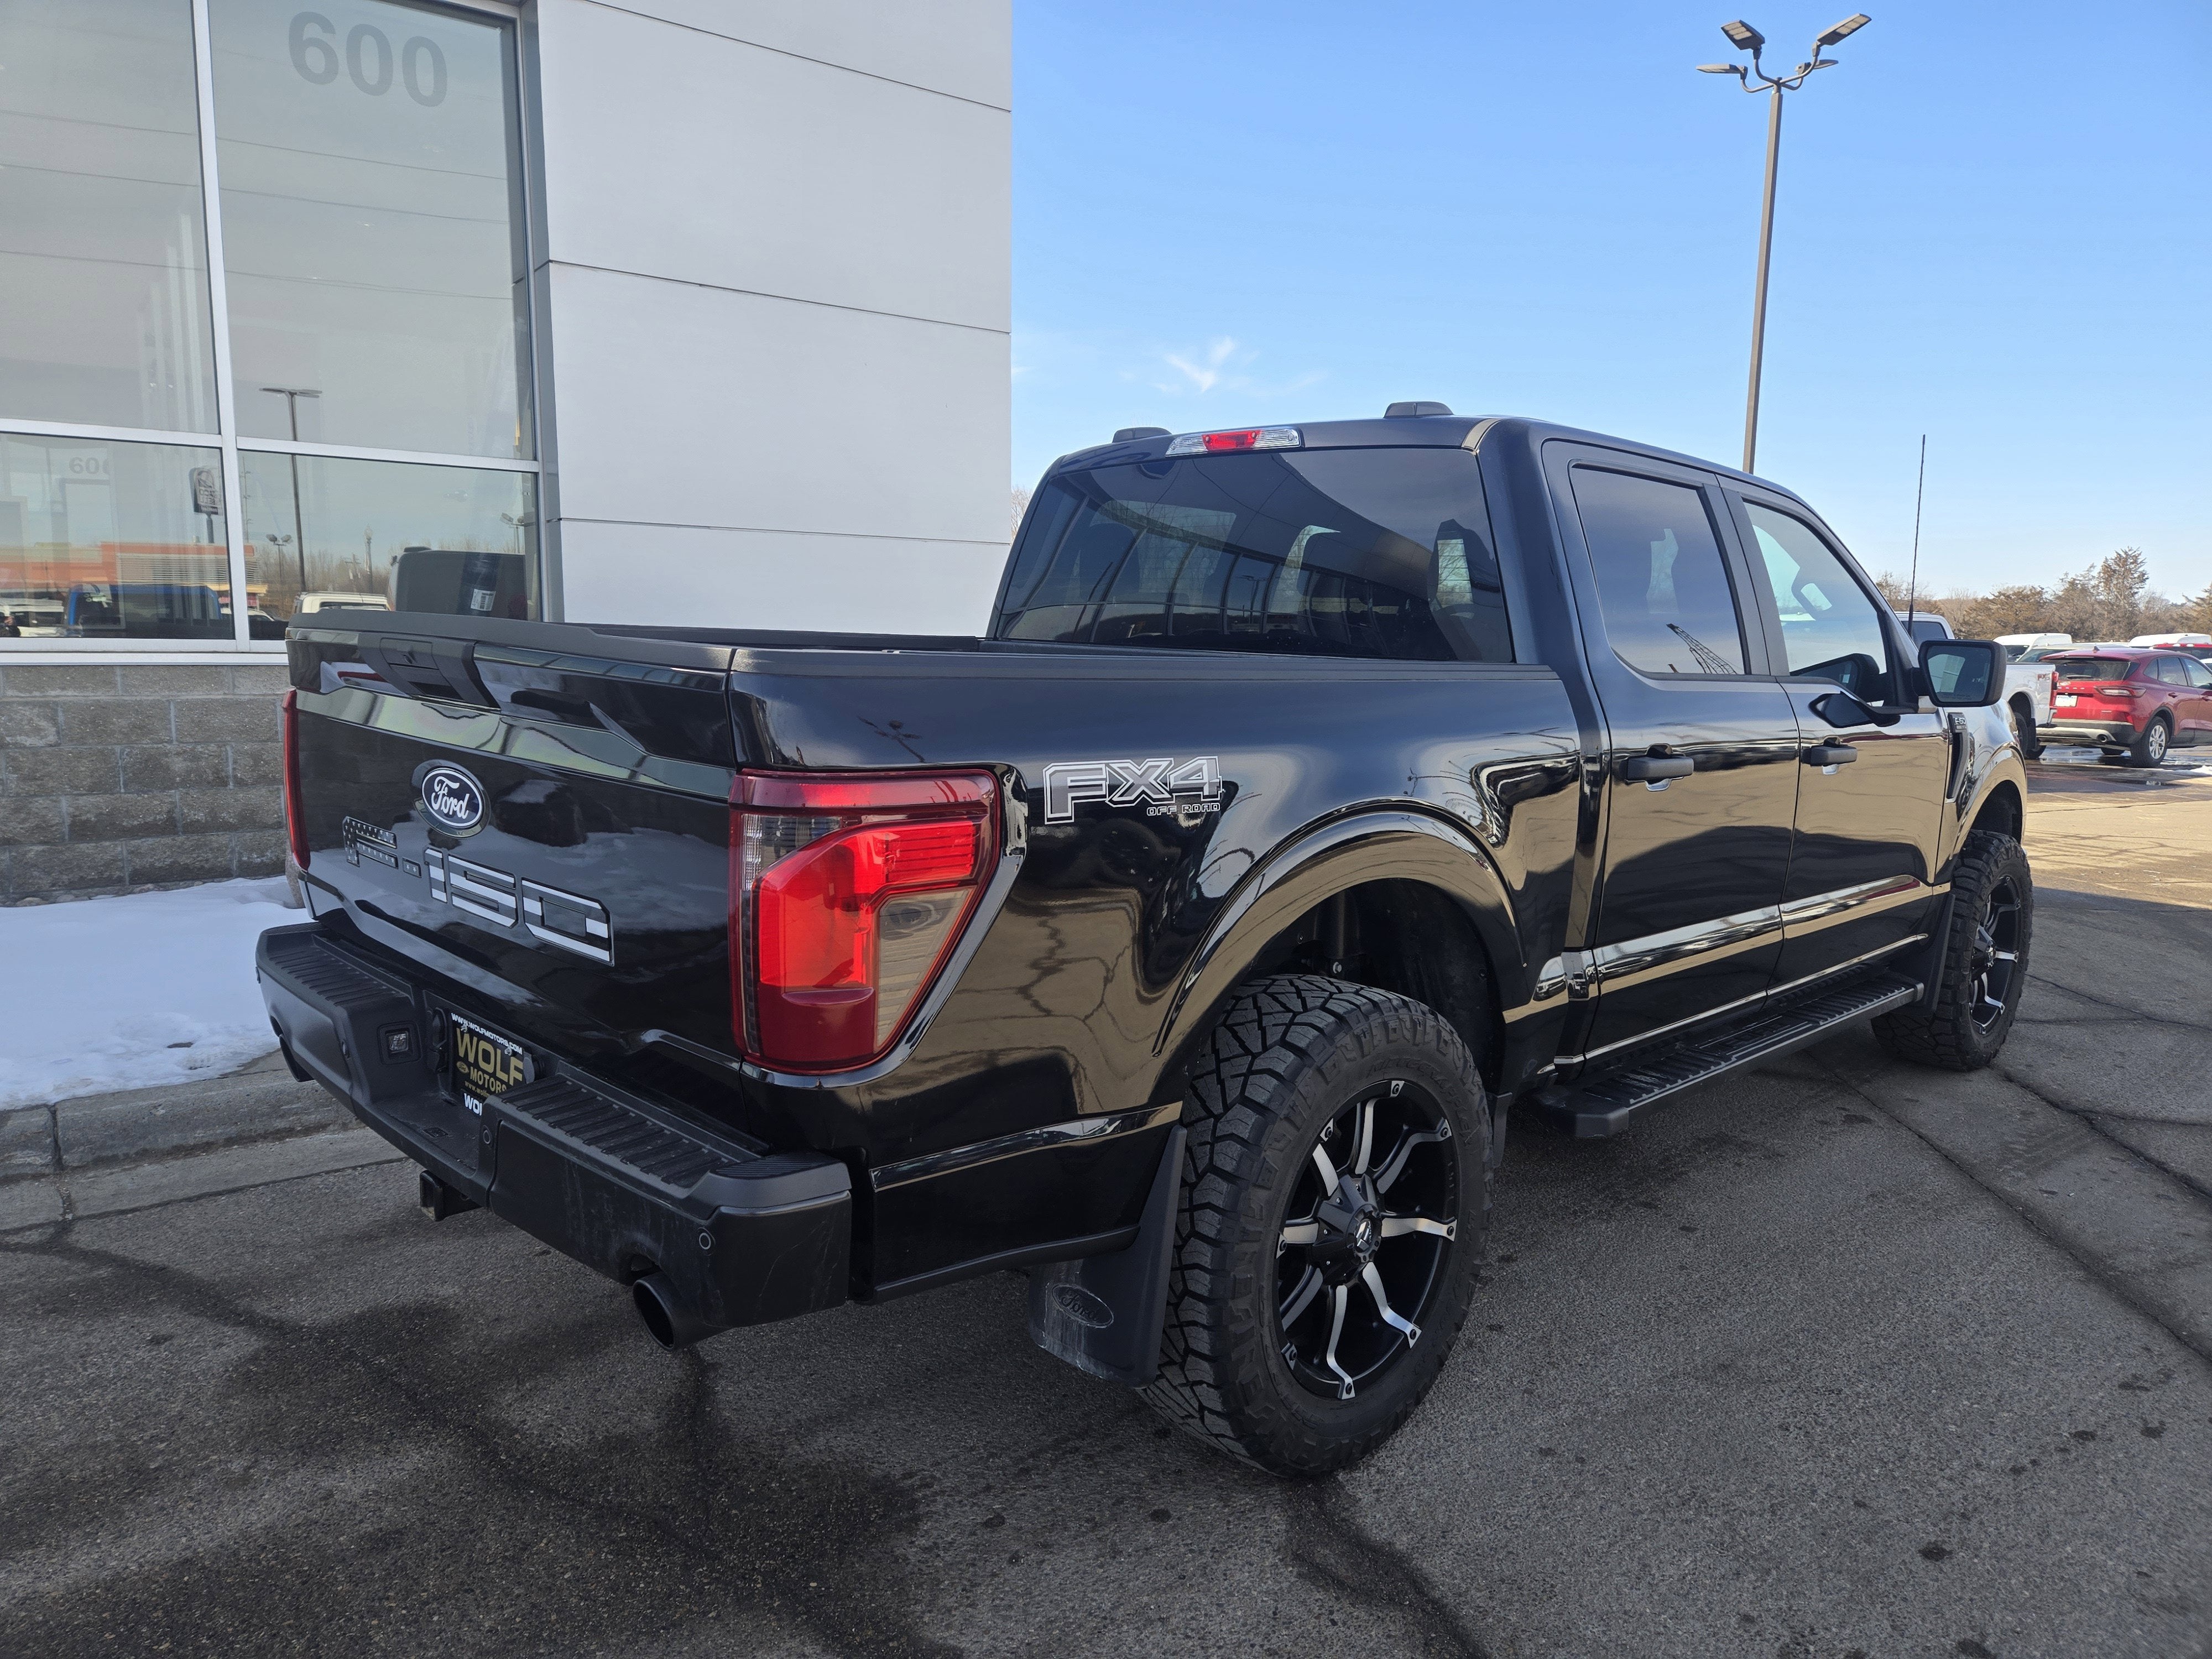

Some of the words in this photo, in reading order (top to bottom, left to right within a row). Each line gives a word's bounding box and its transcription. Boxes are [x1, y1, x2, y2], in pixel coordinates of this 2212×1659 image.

[288, 11, 448, 107] 600
[431, 776, 470, 820] Ford
[1042, 755, 1223, 825] FX4
[1146, 805, 1177, 816] OFF
[1181, 802, 1220, 814] ROAD
[342, 816, 614, 967] F-150
[451, 1013, 523, 1055] WWW.WOLFMOTORS.COM
[456, 1027, 523, 1086] WOLF
[470, 1066, 507, 1094] MOTORS
